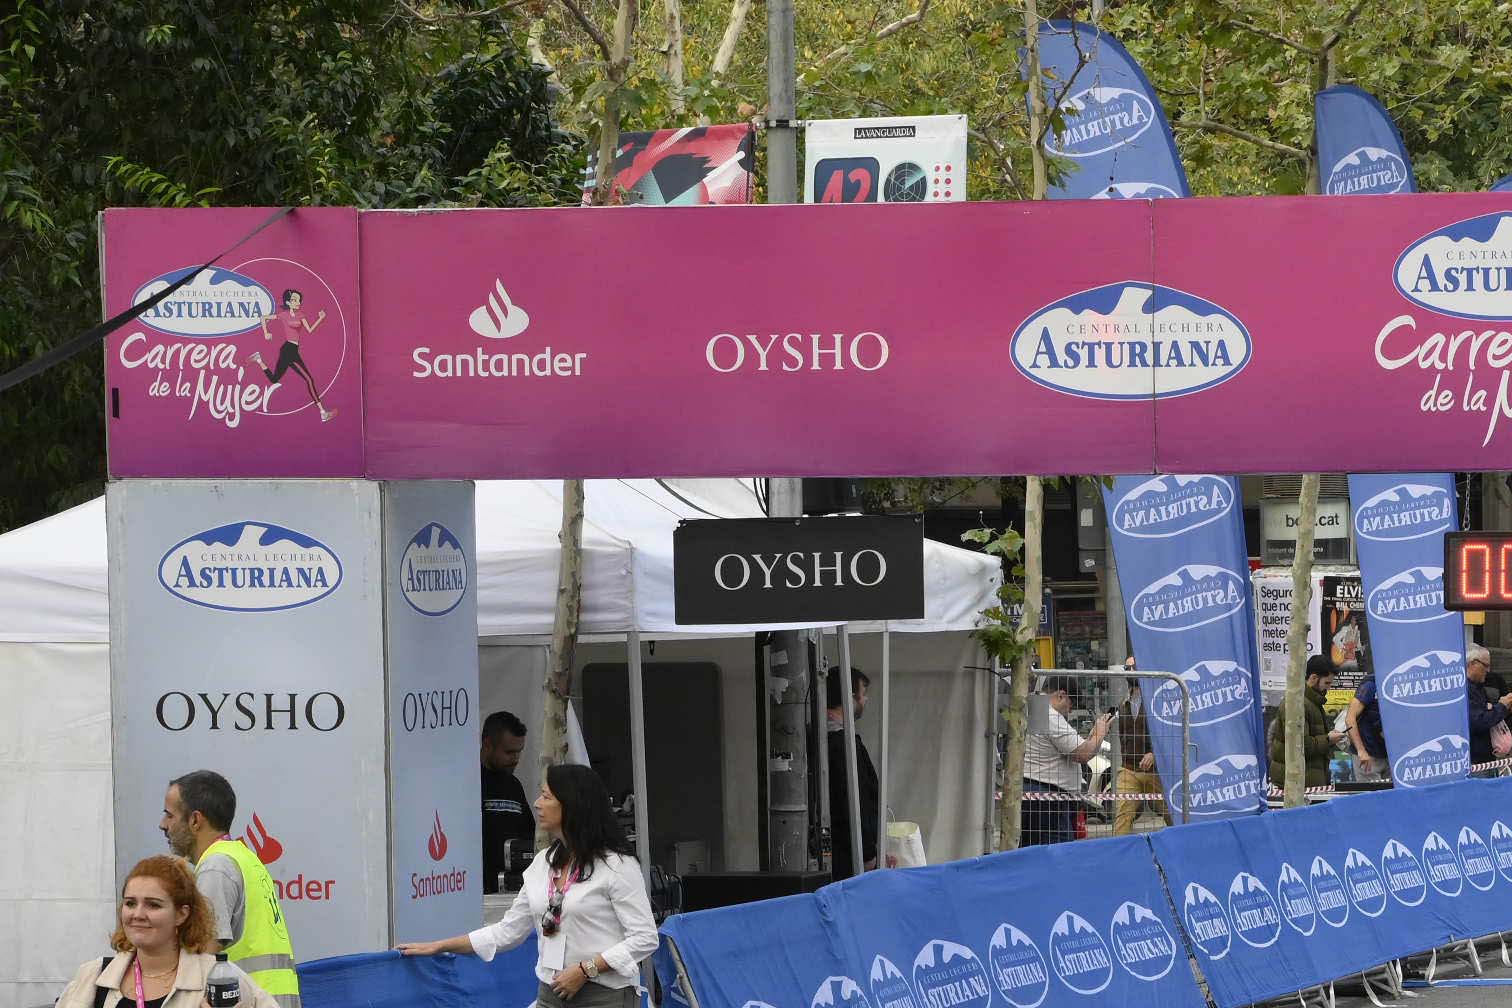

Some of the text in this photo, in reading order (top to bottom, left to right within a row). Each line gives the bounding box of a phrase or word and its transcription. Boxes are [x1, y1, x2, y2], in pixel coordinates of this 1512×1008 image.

[1067, 322, 1226, 335] CENTRAL LECHERA
[120, 332, 237, 370] Carrera
[412, 346, 587, 379] Santander
[706, 331, 889, 373] OYSHO
[1029, 326, 1233, 369] ASTURIANA
[149, 367, 282, 429] de la Mujer
[1420, 373, 1454, 413] de
[1462, 372, 1487, 412] la
[173, 556, 329, 589] ASTURIANA
[200, 552, 323, 562] CENTRAL LECHERA
[405, 556, 464, 592] ASTURIANA
[714, 549, 887, 591] OYSHO
[1262, 602, 1278, 612] que
[1262, 641, 1281, 652] este
[155, 691, 346, 732] OYSHO
[402, 687, 470, 733] OYSHO
[410, 866, 467, 900] Santander
[994, 958, 1046, 991] ASTURIANA
[1054, 945, 1110, 977] ASTURIANA
